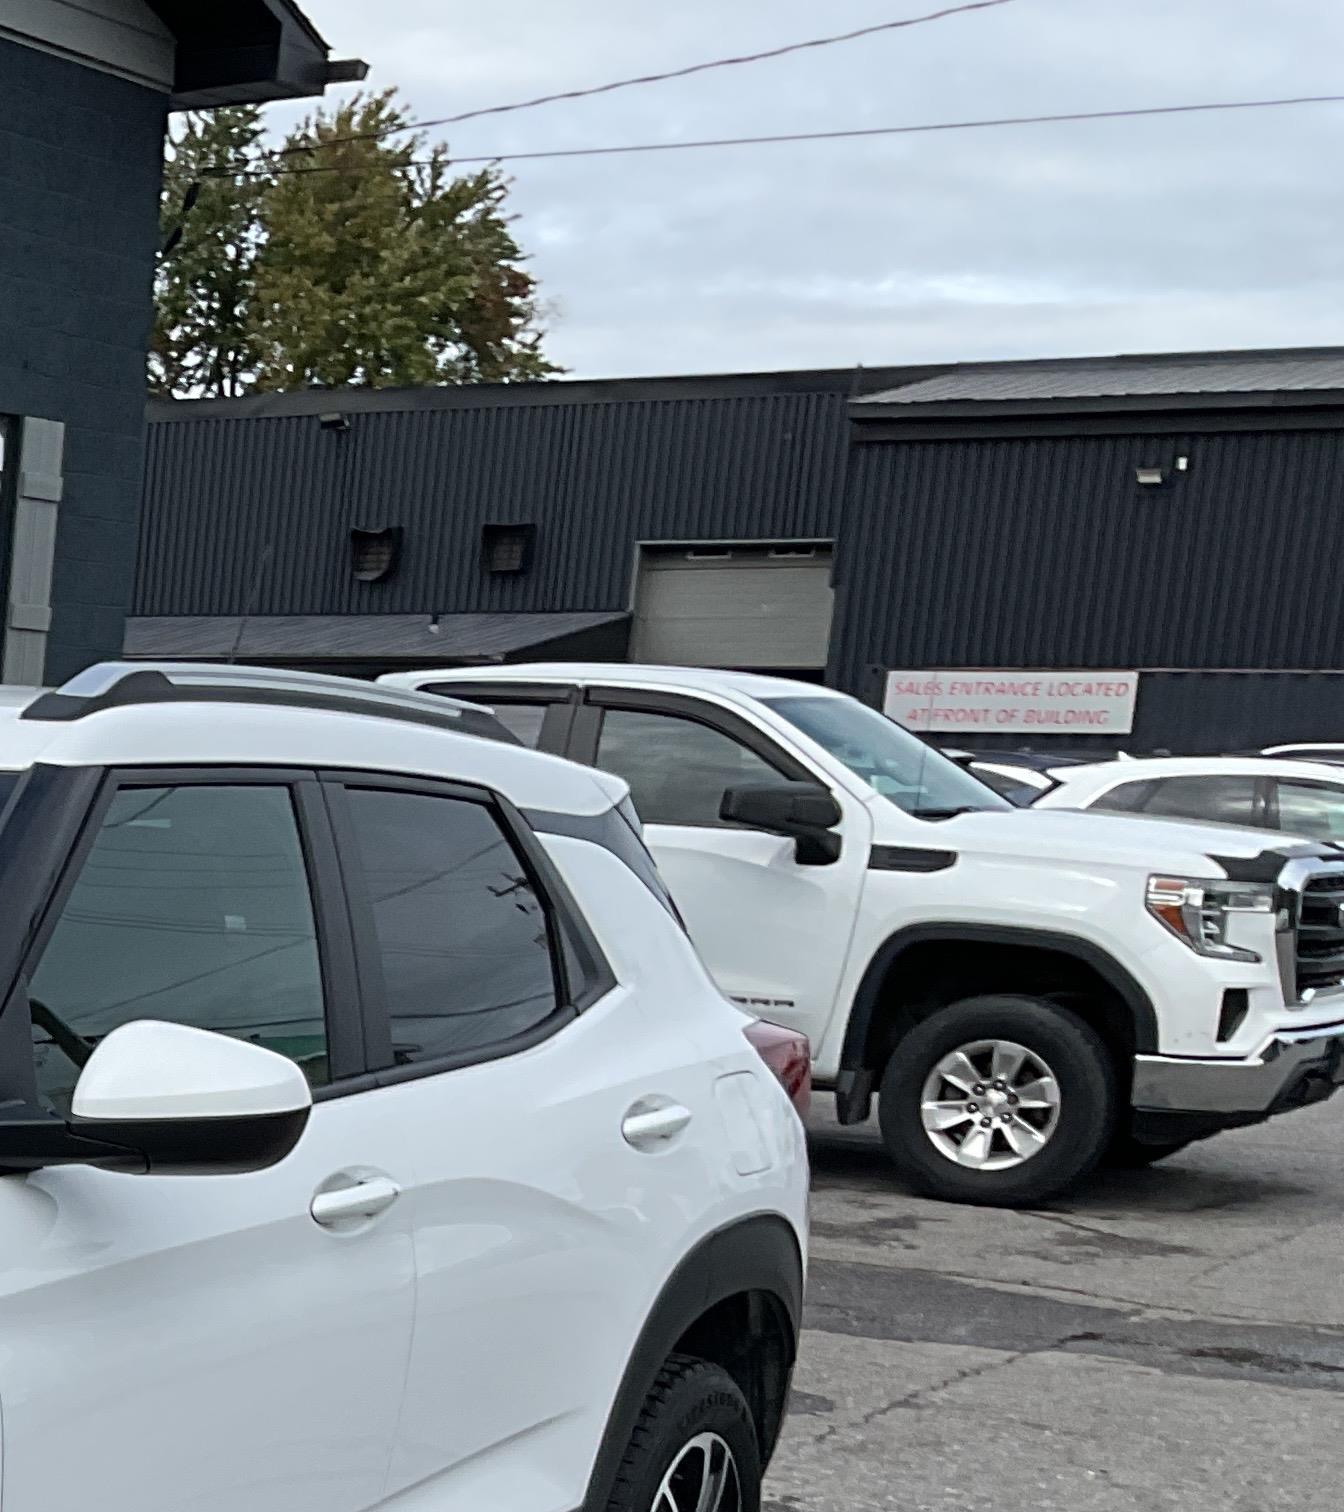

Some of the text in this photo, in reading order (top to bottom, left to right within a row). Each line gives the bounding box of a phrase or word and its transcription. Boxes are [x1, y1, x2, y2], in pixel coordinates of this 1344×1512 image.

[895, 681, 1130, 698] SALES ENTRANCE LOCATED
[906, 708, 1111, 726] AT FRONT OF BUILDING
